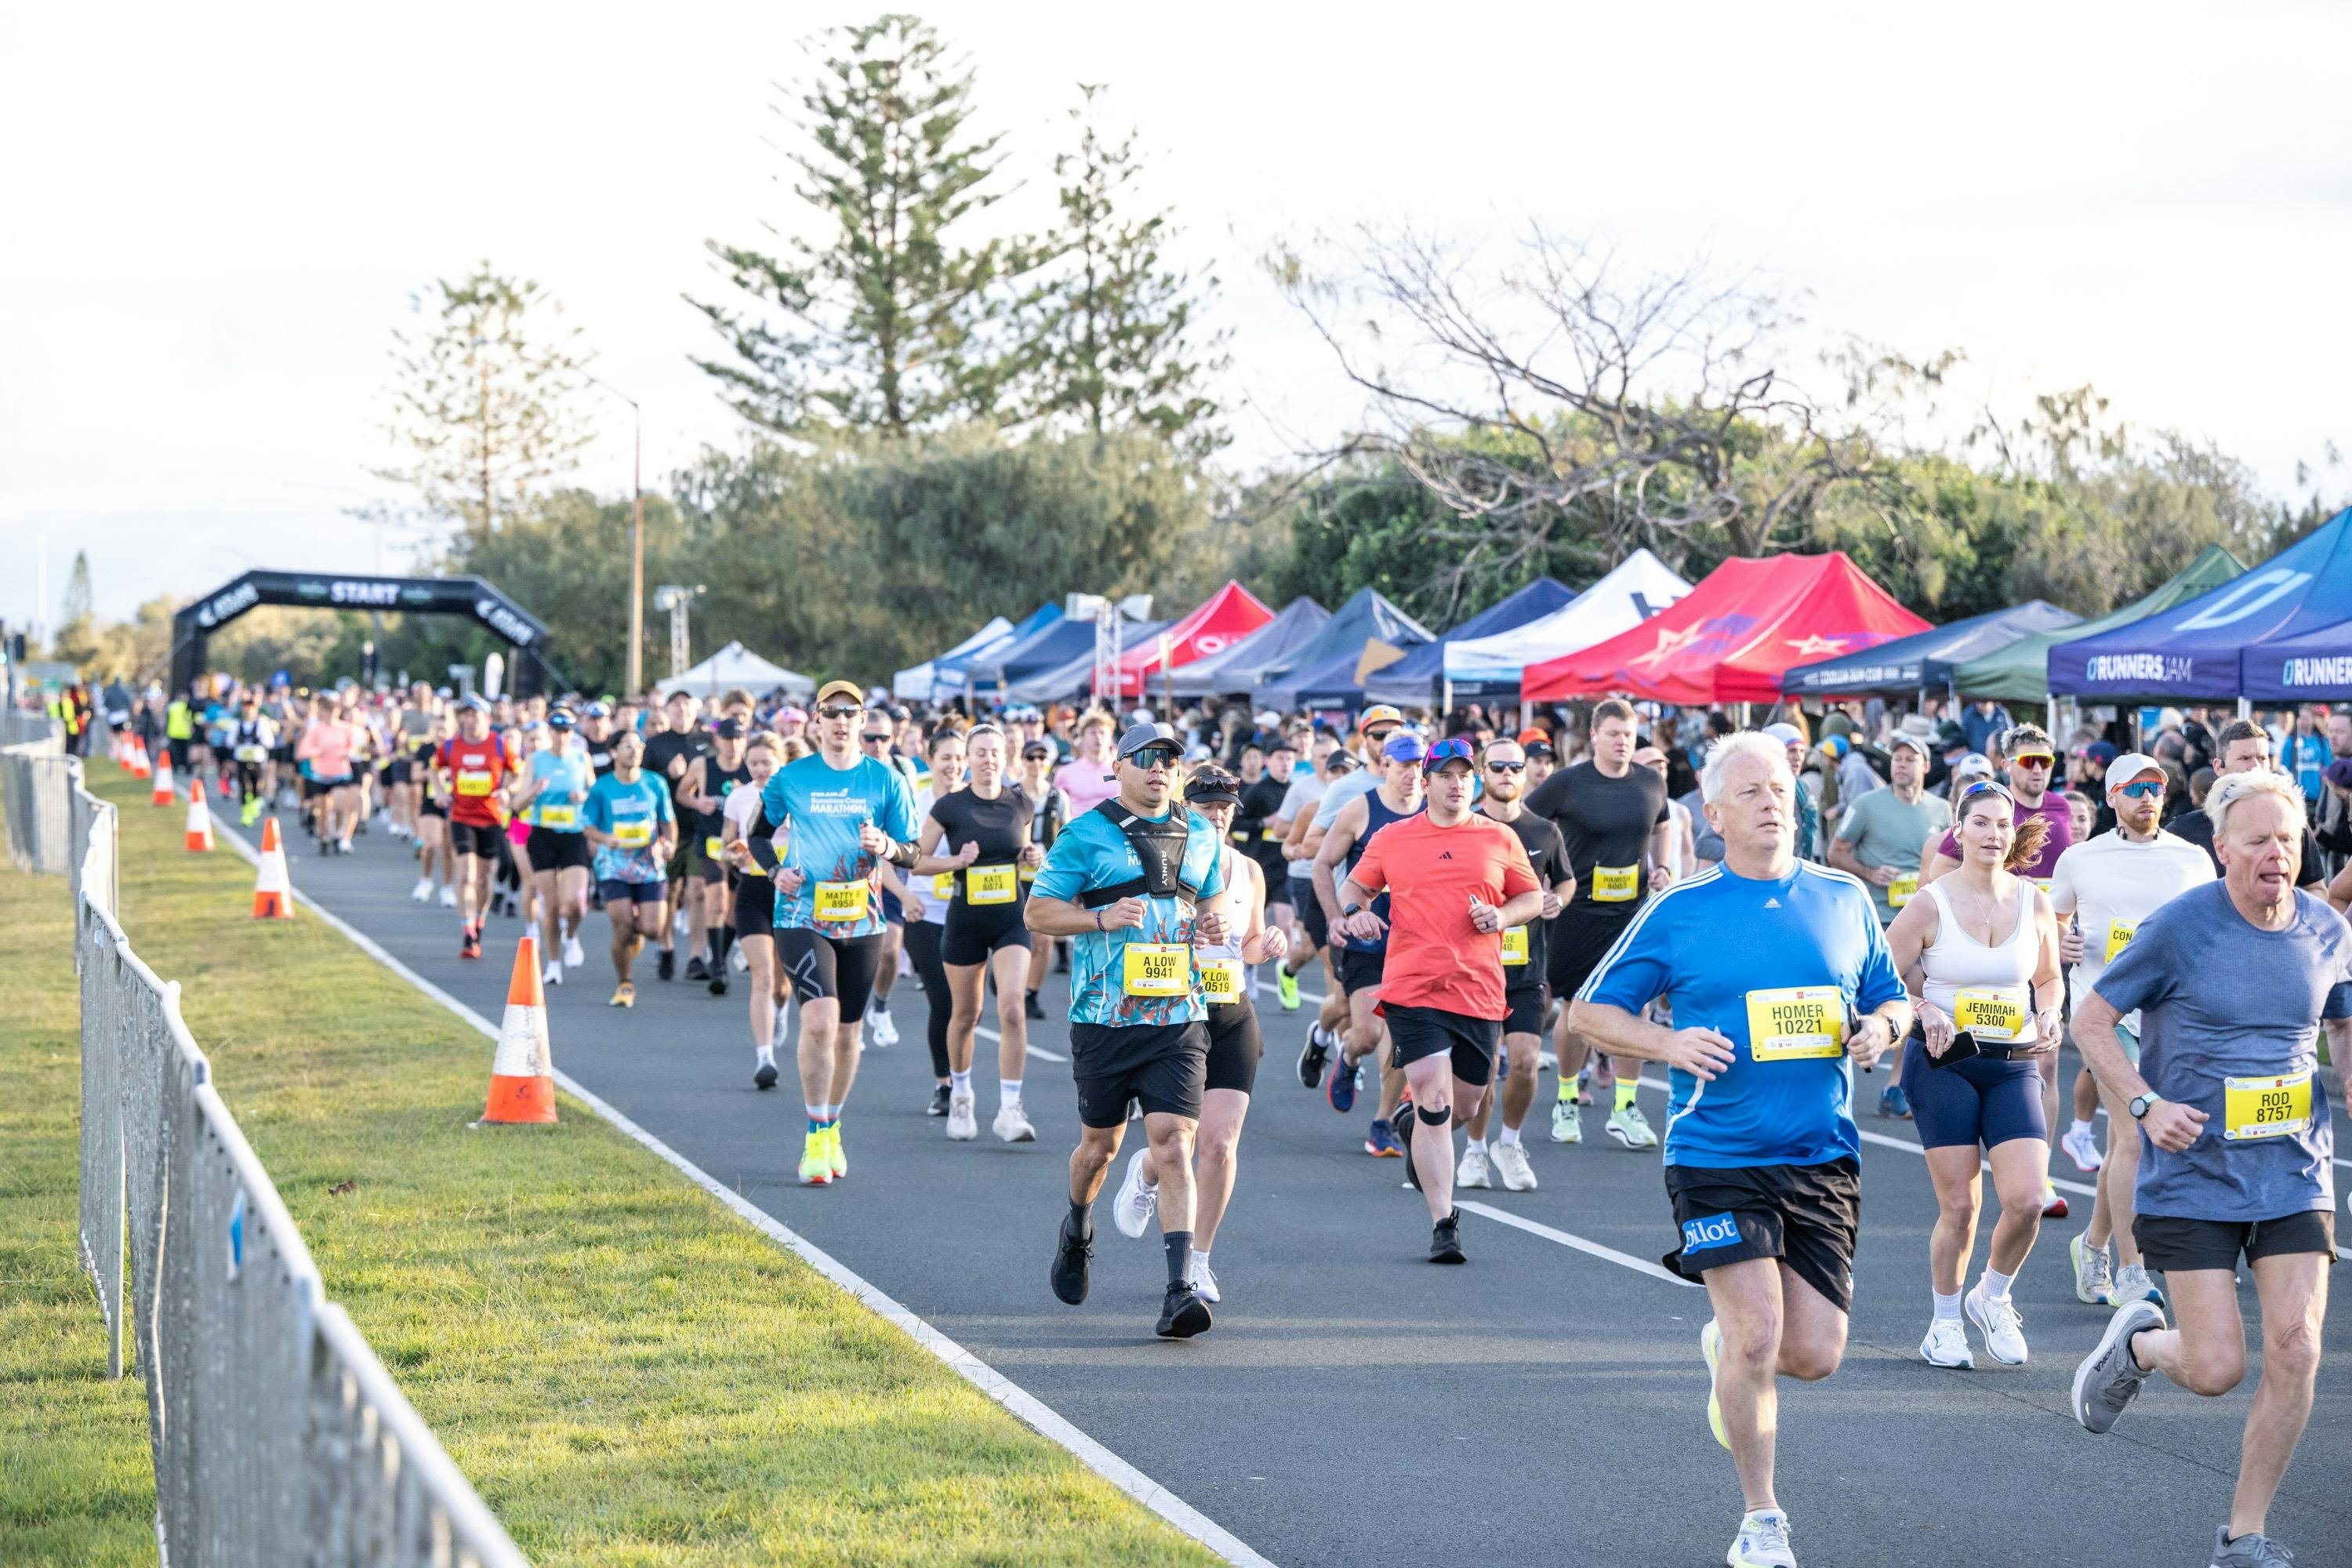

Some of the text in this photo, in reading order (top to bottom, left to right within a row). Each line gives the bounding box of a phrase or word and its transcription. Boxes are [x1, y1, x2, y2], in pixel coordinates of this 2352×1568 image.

[330, 581, 401, 604] START
[2293, 656, 2352, 686] RUNNER
[811, 804, 866, 814] MARATHON
[831, 899, 854, 908] 8958
[1503, 935, 1515, 943] SE
[2113, 930, 2132, 941] CON
[1143, 956, 1176, 967] A LOW
[1145, 967, 1173, 978] 9941
[1210, 971, 1230, 982] LOW
[1204, 981, 1230, 993] 0519
[1772, 1004, 1824, 1020] HOMER
[1965, 1002, 2016, 1017] JEMIMAH
[1775, 1018, 1822, 1035] 10221
[1976, 1014, 2005, 1027] 5300
[2262, 1091, 2289, 1107] ROD
[2256, 1105, 2292, 1123] 8757
[1682, 1218, 1737, 1254] pilot
[2093, 1343, 2116, 1373] HOKA
